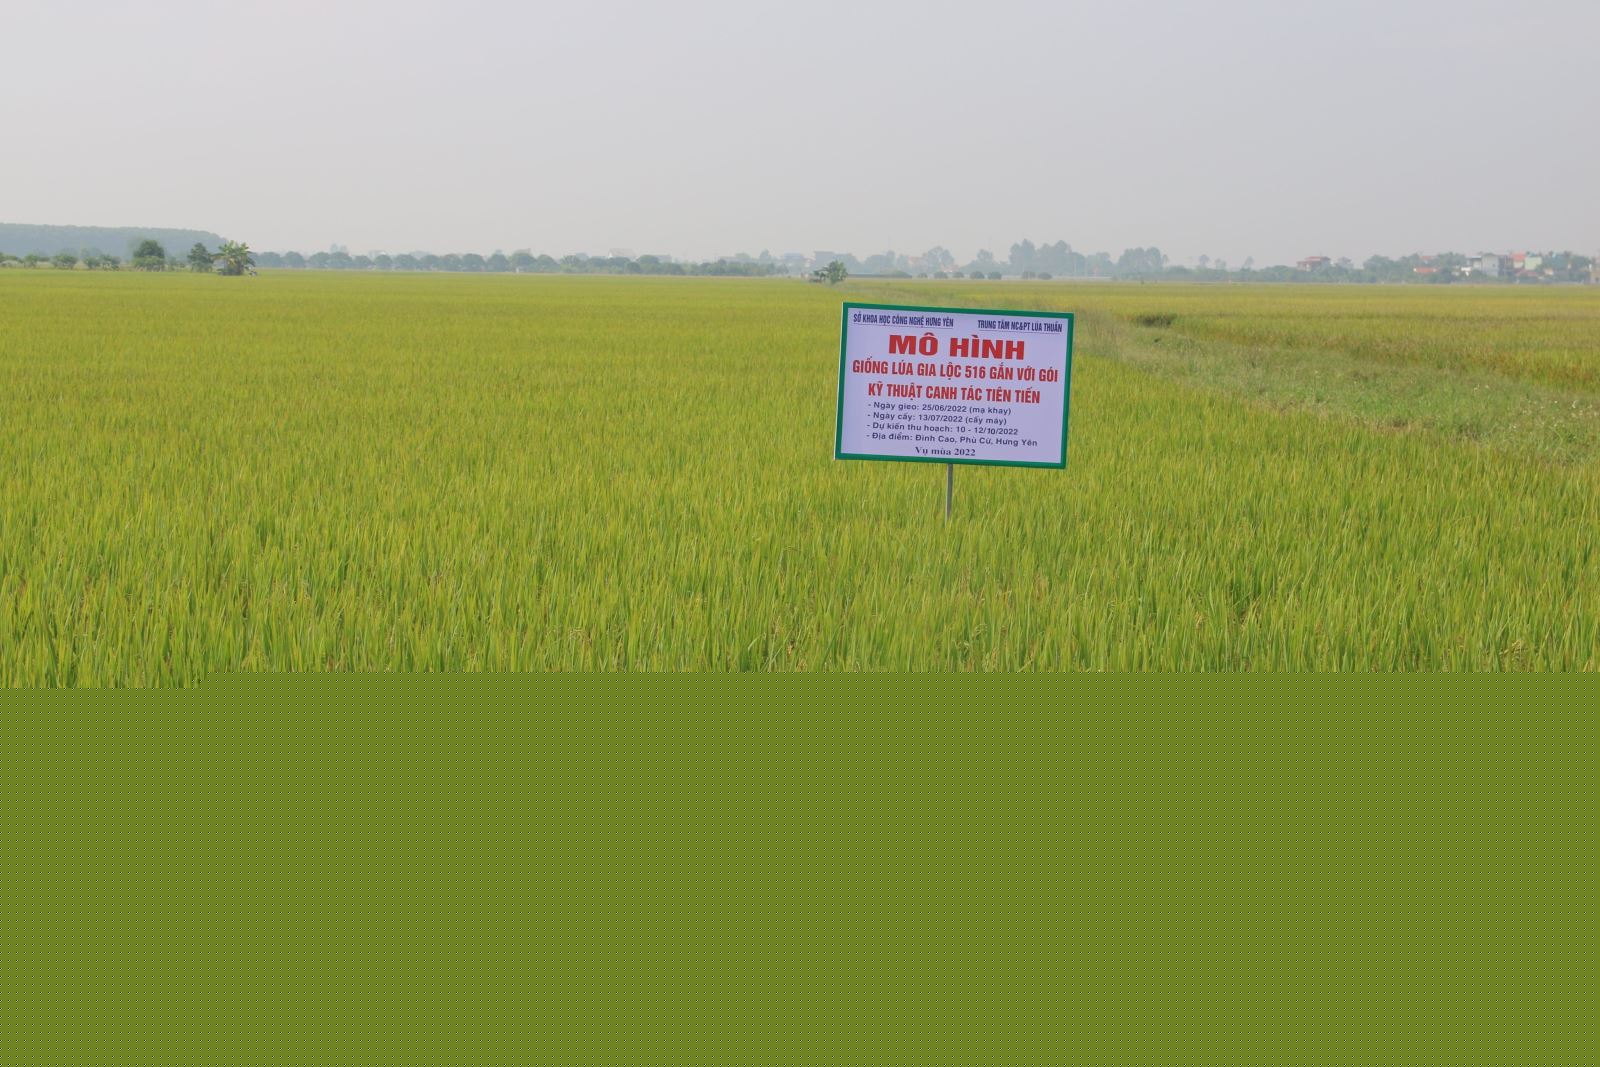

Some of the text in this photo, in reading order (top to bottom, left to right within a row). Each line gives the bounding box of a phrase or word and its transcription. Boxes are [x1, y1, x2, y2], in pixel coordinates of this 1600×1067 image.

[863, 315, 877, 324] KHOA
[879, 316, 890, 326] HỌC
[892, 315, 908, 325] CÔNG
[909, 317, 924, 328] NGHỆ
[943, 318, 954, 327] YÊN
[978, 320, 996, 329] TRUNG
[998, 320, 1010, 330] TÂM
[1011, 322, 1030, 331] NC&PT
[889, 332, 1025, 360] MÔ HÌNH
[853, 356, 1058, 382] GIỐNG LÚA GIA LỘC 516 GẮN VỚI GÓI
[868, 381, 1040, 403] KỸ THUẬT CANH TÁC TIÊN TIẾN
[873, 402, 895, 410] Ngày
[922, 404, 967, 413] 25/06/2022
[969, 406, 985, 414] (mạ
[987, 407, 1011, 415] khay)
[873, 412, 894, 420] Ngày
[897, 412, 915, 421] cấy:
[919, 414, 963, 422] 13/07/2022
[965, 415, 983, 424] (cấy
[985, 417, 1007, 425] máy)
[872, 422, 884, 430] Dự
[887, 422, 904, 430] kiến
[924, 425, 953, 433] hoạch:
[974, 427, 1018, 435] 12/10/2022
[872, 432, 885, 440] Địa
[888, 432, 912, 441] điểm:
[915, 434, 935, 442] Đình
[938, 435, 957, 443] Cao,
[960, 436, 976, 444] Phù
[995, 438, 1018, 447] Hưng
[915, 446, 928, 455] Vụ
[954, 448, 975, 456] 2022
